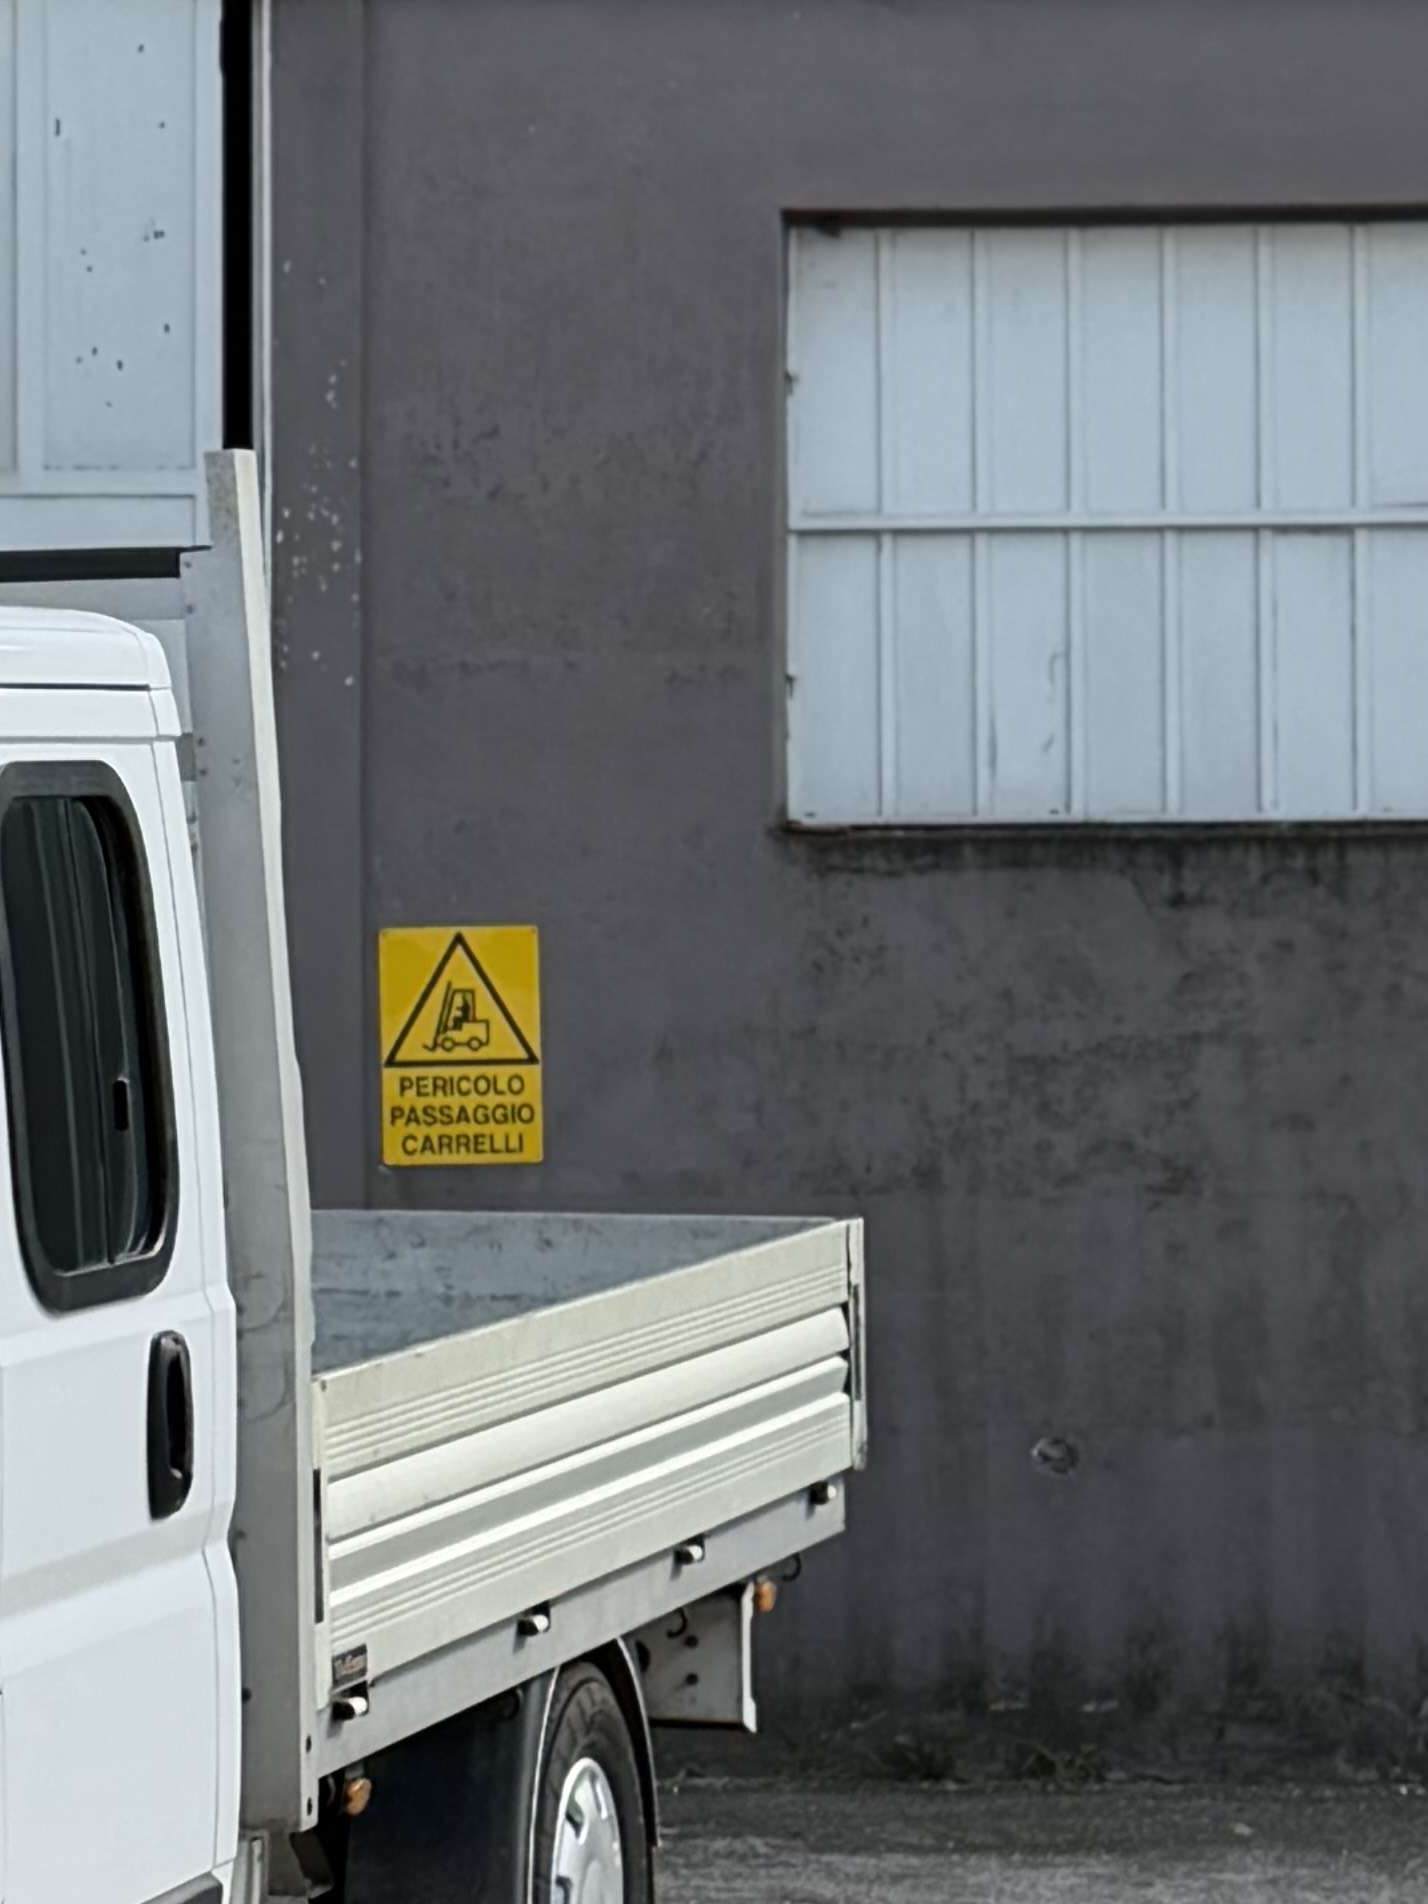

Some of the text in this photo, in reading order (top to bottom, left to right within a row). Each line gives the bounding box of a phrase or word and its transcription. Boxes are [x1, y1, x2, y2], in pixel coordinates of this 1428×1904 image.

[399, 1074, 526, 1098] PERICOLO
[390, 1102, 536, 1128] PASSAGGIO
[401, 1132, 525, 1157] CARRELLI
